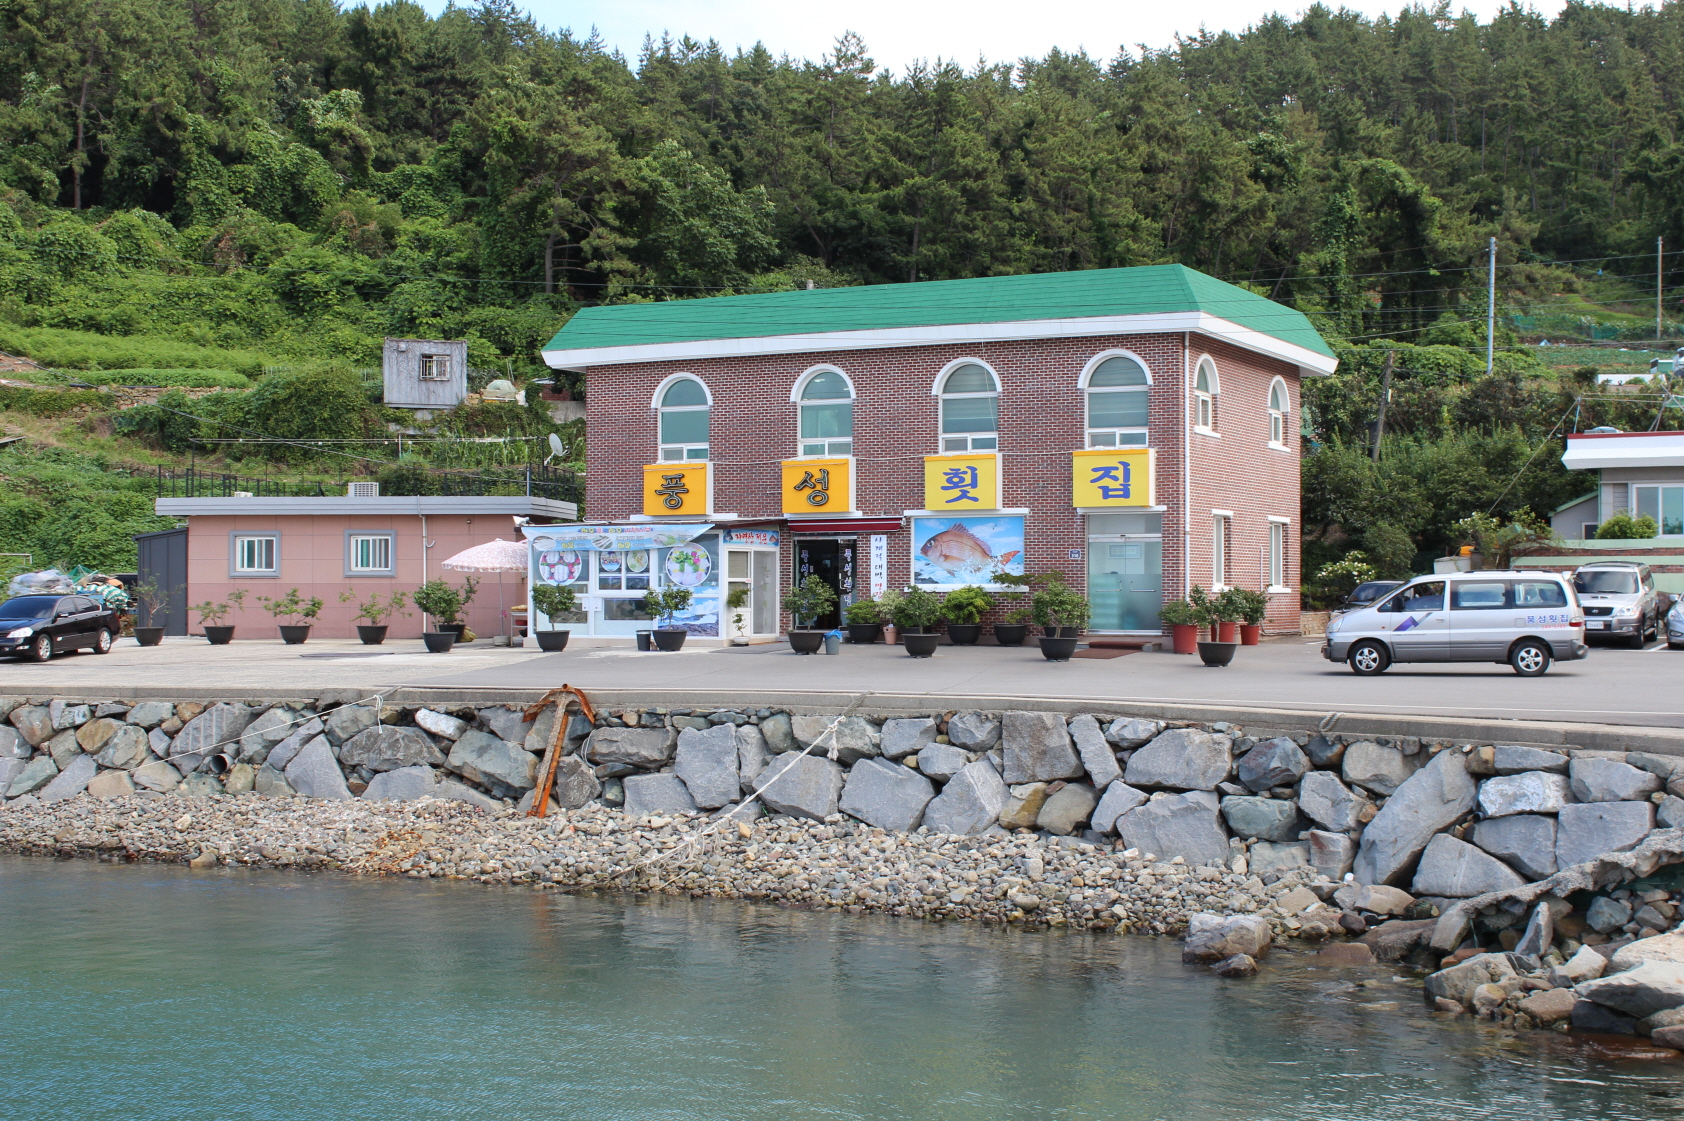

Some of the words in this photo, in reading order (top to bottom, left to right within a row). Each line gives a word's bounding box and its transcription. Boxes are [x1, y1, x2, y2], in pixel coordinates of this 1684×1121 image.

[654, 472, 690, 510] 풍
[793, 468, 830, 507] 성
[940, 465, 980, 504] 횟
[1089, 460, 1132, 500] 집
[1527, 614, 1569, 624] 풍성횟집
